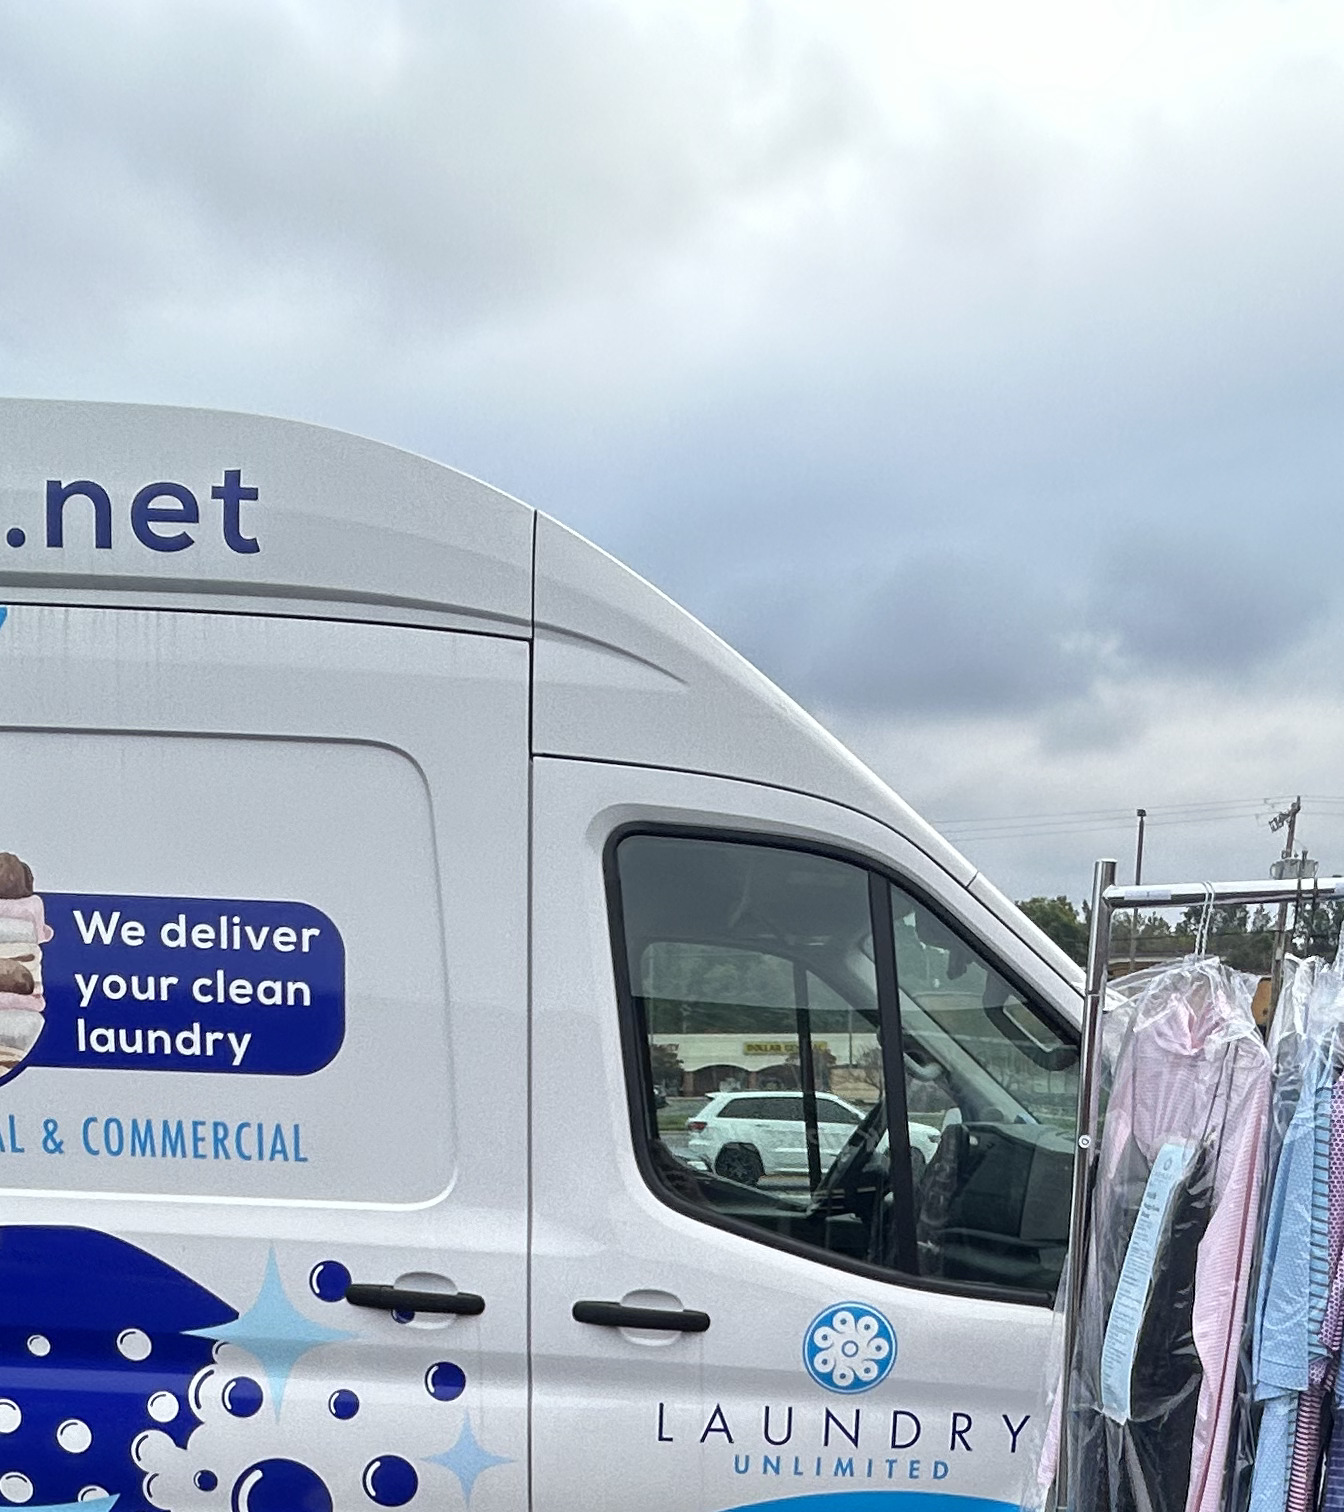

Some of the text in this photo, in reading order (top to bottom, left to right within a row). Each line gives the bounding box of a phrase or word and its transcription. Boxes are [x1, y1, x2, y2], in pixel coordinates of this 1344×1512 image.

[72, 910, 321, 954] We deliver
[74, 969, 312, 1010] your clean
[75, 1018, 253, 1066] laundry
[42, 1118, 65, 1155] &
[82, 1116, 309, 1163] COMMERCIAL
[658, 1401, 1031, 1454] LAUNDRY
[733, 1454, 949, 1479] UNLIMITED
